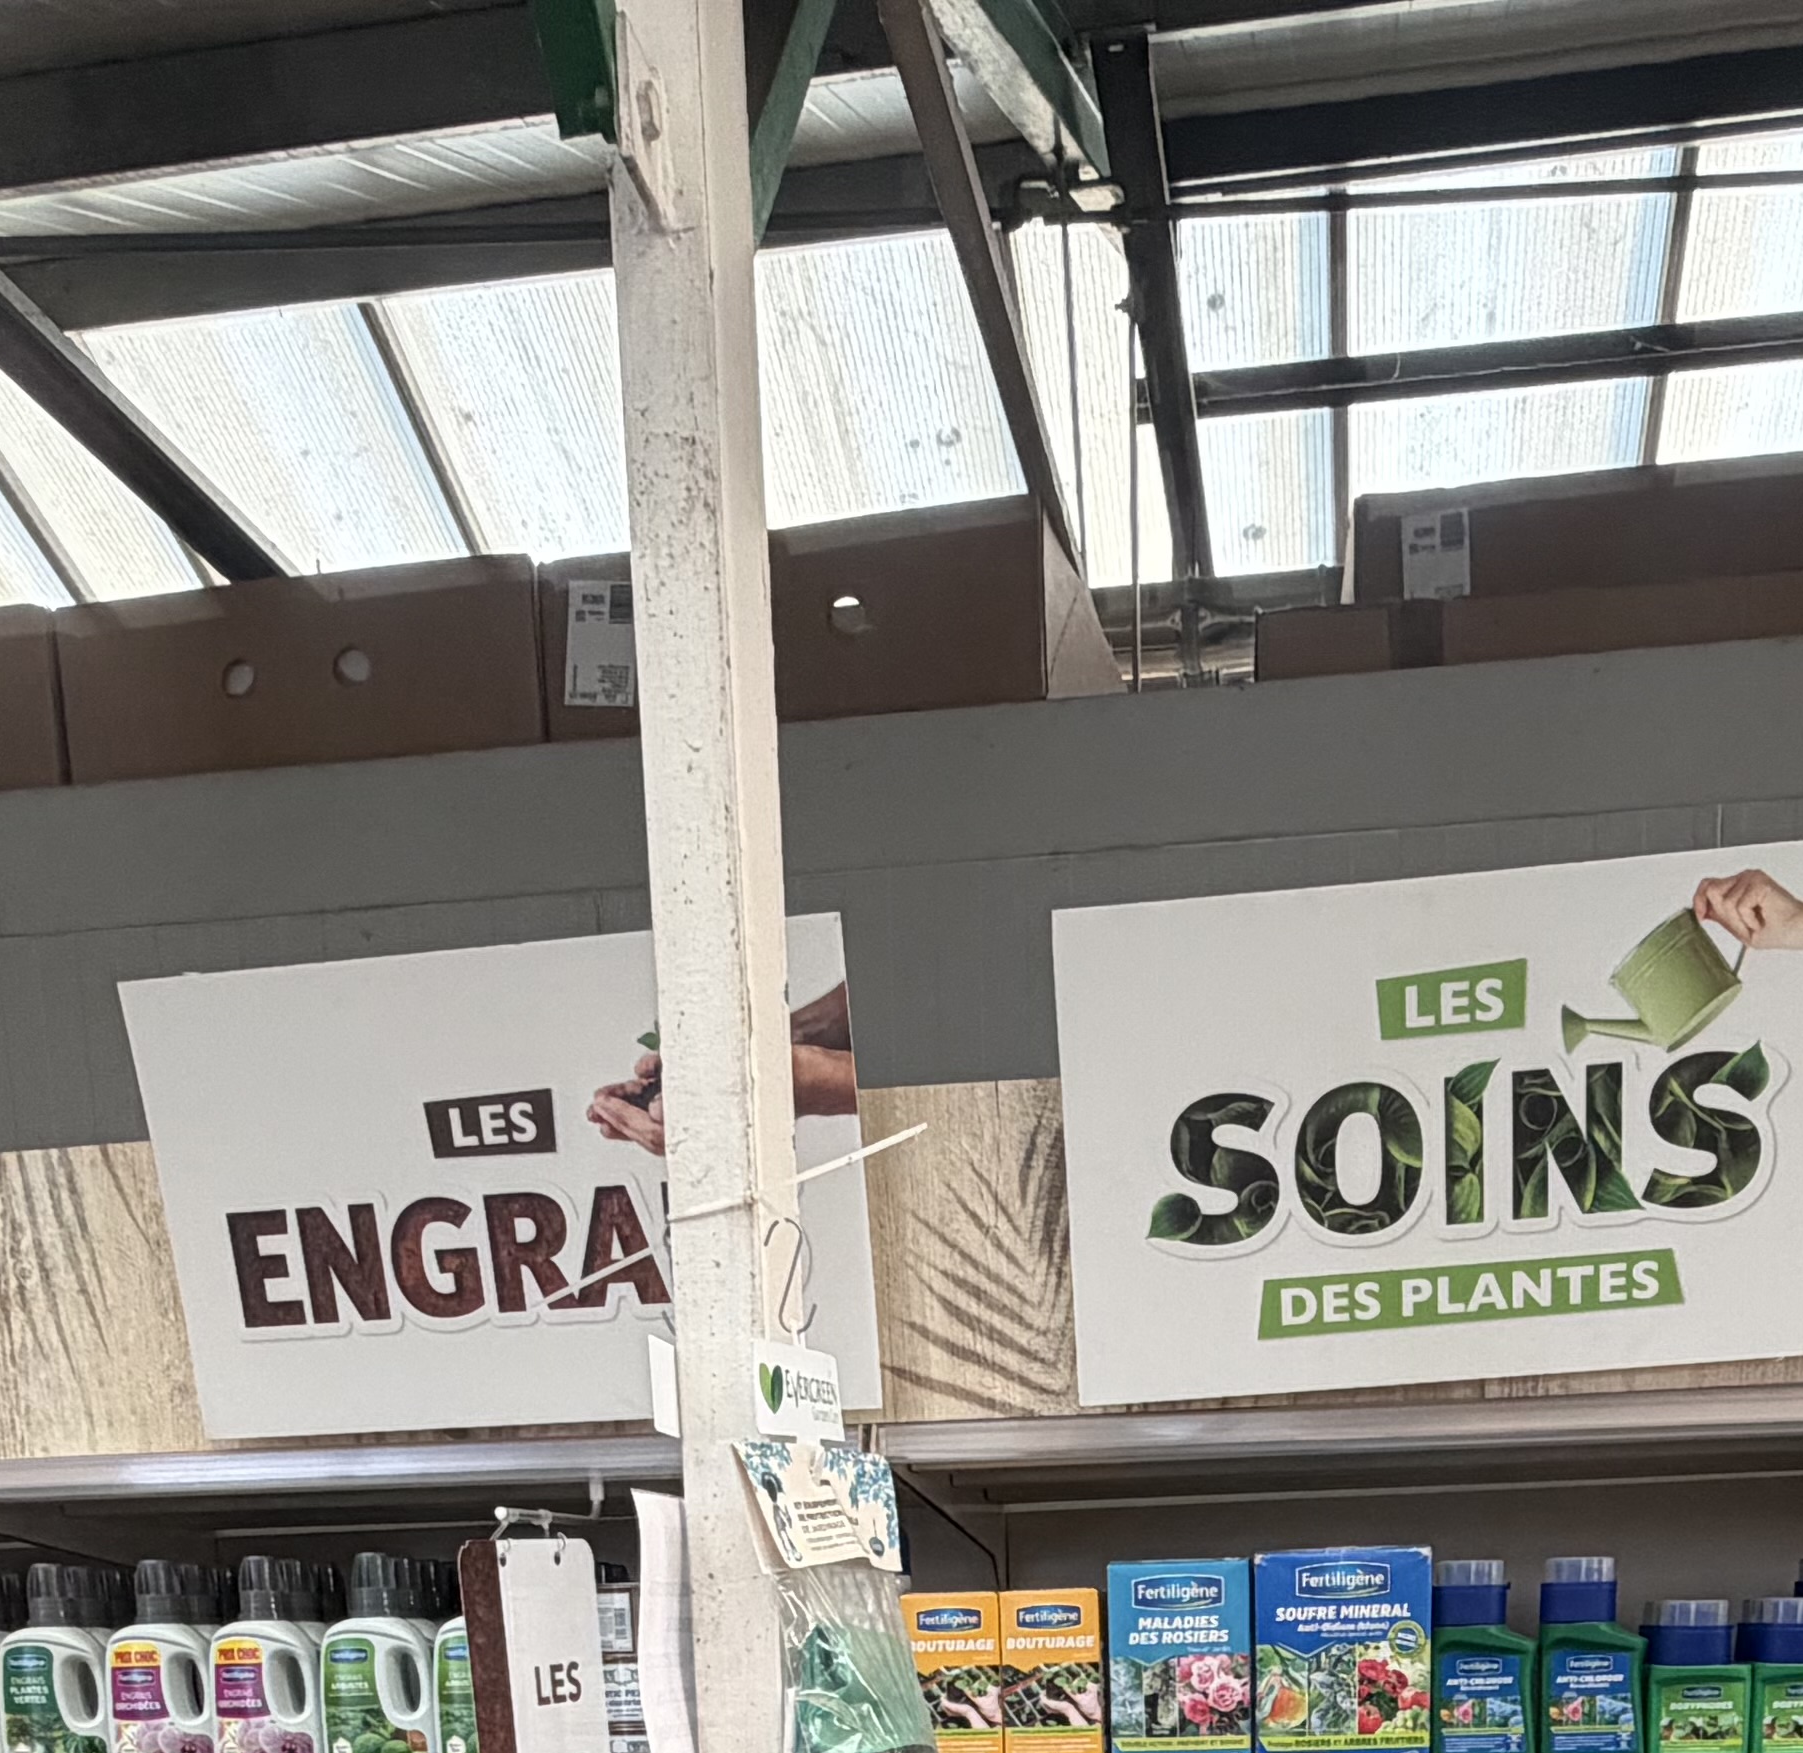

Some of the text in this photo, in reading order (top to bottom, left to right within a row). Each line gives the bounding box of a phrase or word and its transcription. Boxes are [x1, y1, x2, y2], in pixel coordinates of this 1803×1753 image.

[1406, 978, 1504, 1029] LES
[447, 1102, 537, 1148] LES
[1146, 1039, 1772, 1247] SOINS
[226, 1182, 672, 1328] ENGRA
[1279, 1261, 1661, 1327] DES PLANTES
[1137, 1581, 1219, 1606] Fertiligène
[1301, 1568, 1385, 1591] Fertiligène
[1138, 1616, 1219, 1629] MALADIES
[1276, 1603, 1411, 1621] SOUFRE MINERAL
[1007, 1636, 1095, 1649] BOUTURAGE
[1129, 1630, 1229, 1645] DES ROSIERS
[534, 1661, 583, 1706] LES
